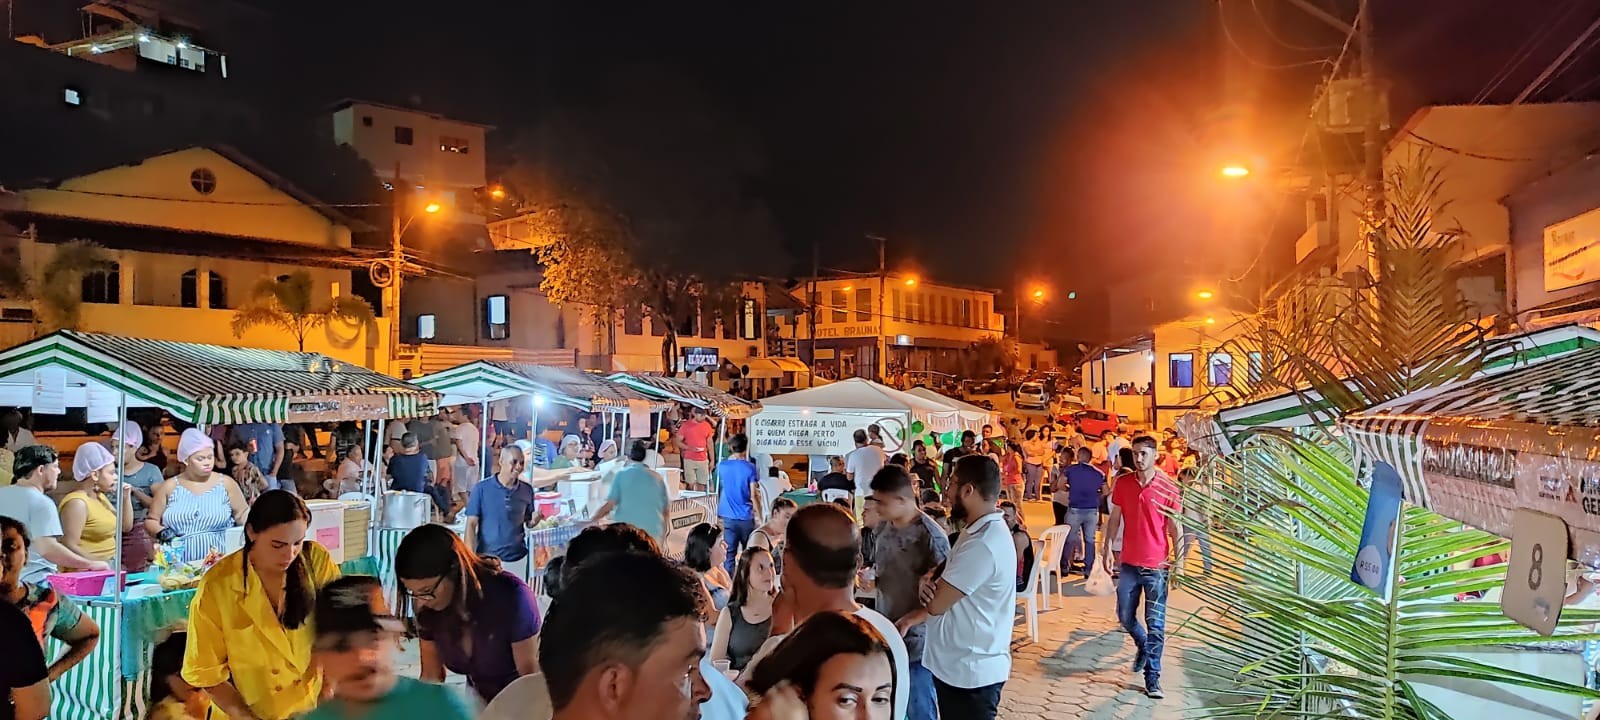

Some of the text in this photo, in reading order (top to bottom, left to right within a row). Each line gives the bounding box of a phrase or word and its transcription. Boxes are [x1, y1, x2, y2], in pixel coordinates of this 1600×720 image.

[815, 328, 839, 337] OTEL
[754, 418, 847, 428] O CIGARRO ESTRAGA A VIDA
[767, 429, 786, 437] QUEM
[788, 429, 809, 437] CHEGA
[813, 430, 835, 438] PERTO
[796, 439, 813, 447] ESSE
[1527, 543, 1543, 591] 8
